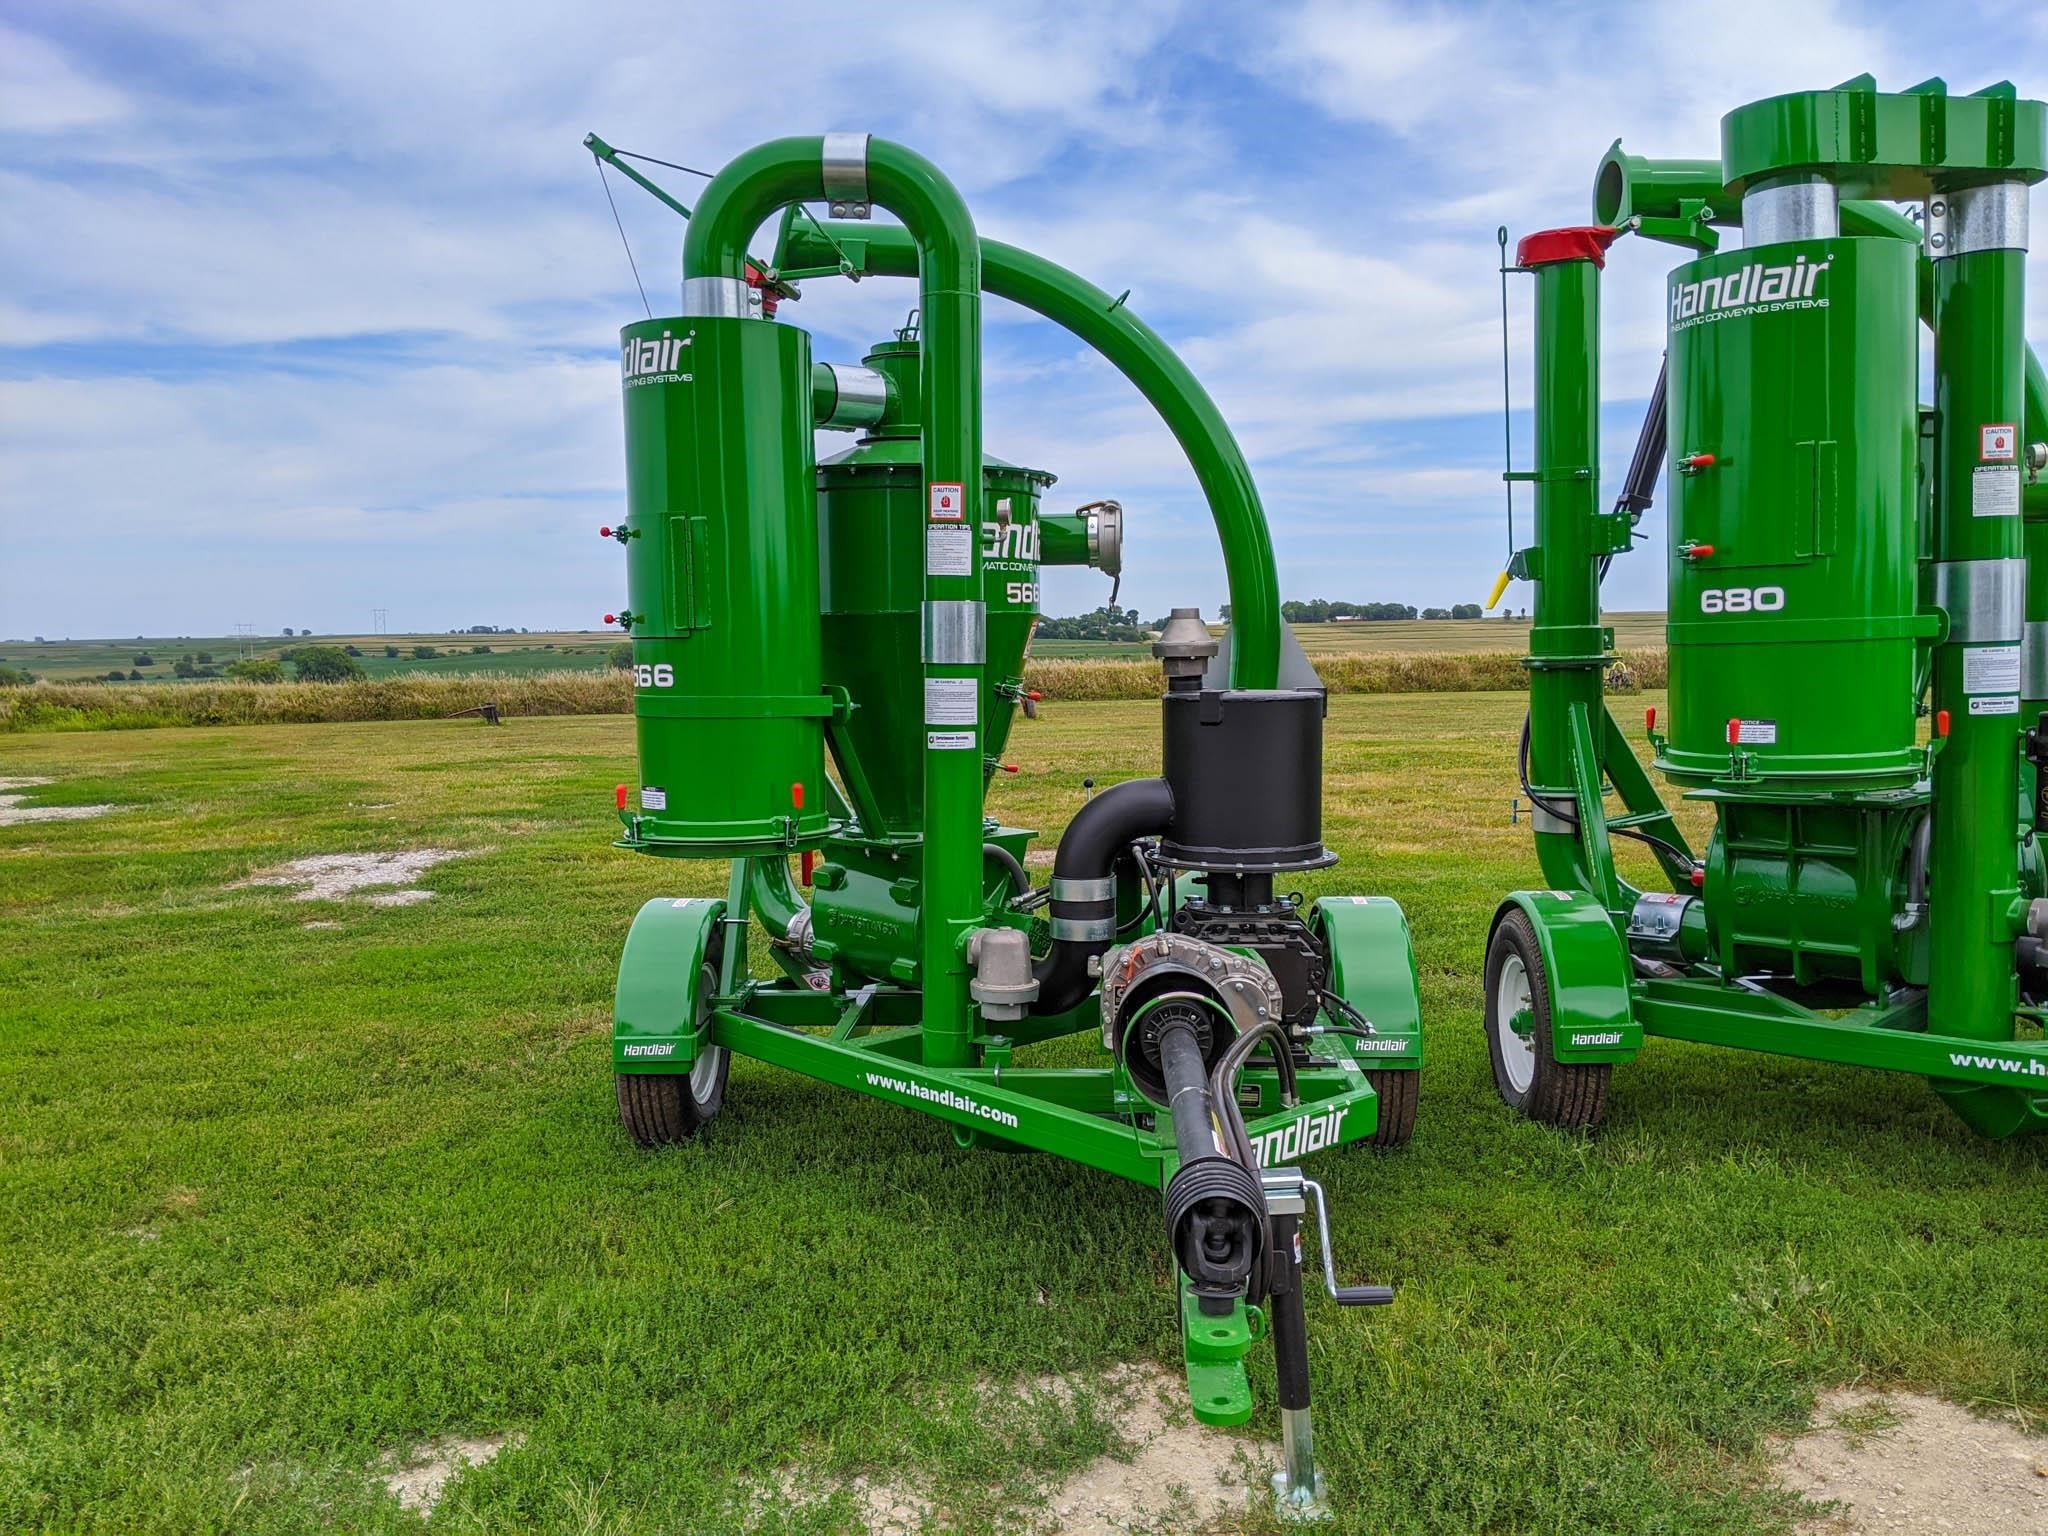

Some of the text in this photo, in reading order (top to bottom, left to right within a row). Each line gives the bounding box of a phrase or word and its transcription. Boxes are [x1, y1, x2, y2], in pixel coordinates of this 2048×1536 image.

[1671, 255, 1829, 323] Handlair
[1705, 305, 1769, 323] CONVEYING
[1770, 299, 1830, 312] SYSTEMS
[623, 331, 692, 379] dlair
[646, 373, 693, 385] SYSTEMS
[1701, 586, 1785, 613] 680
[623, 1043, 676, 1057] Handlair
[1355, 1038, 1409, 1051] Handlair
[1571, 1031, 1623, 1045] Handlair
[1949, 1053, 2048, 1077] www.h
[865, 1072, 1019, 1128] www.handlair.com
[1250, 1104, 1349, 1169] andlair
